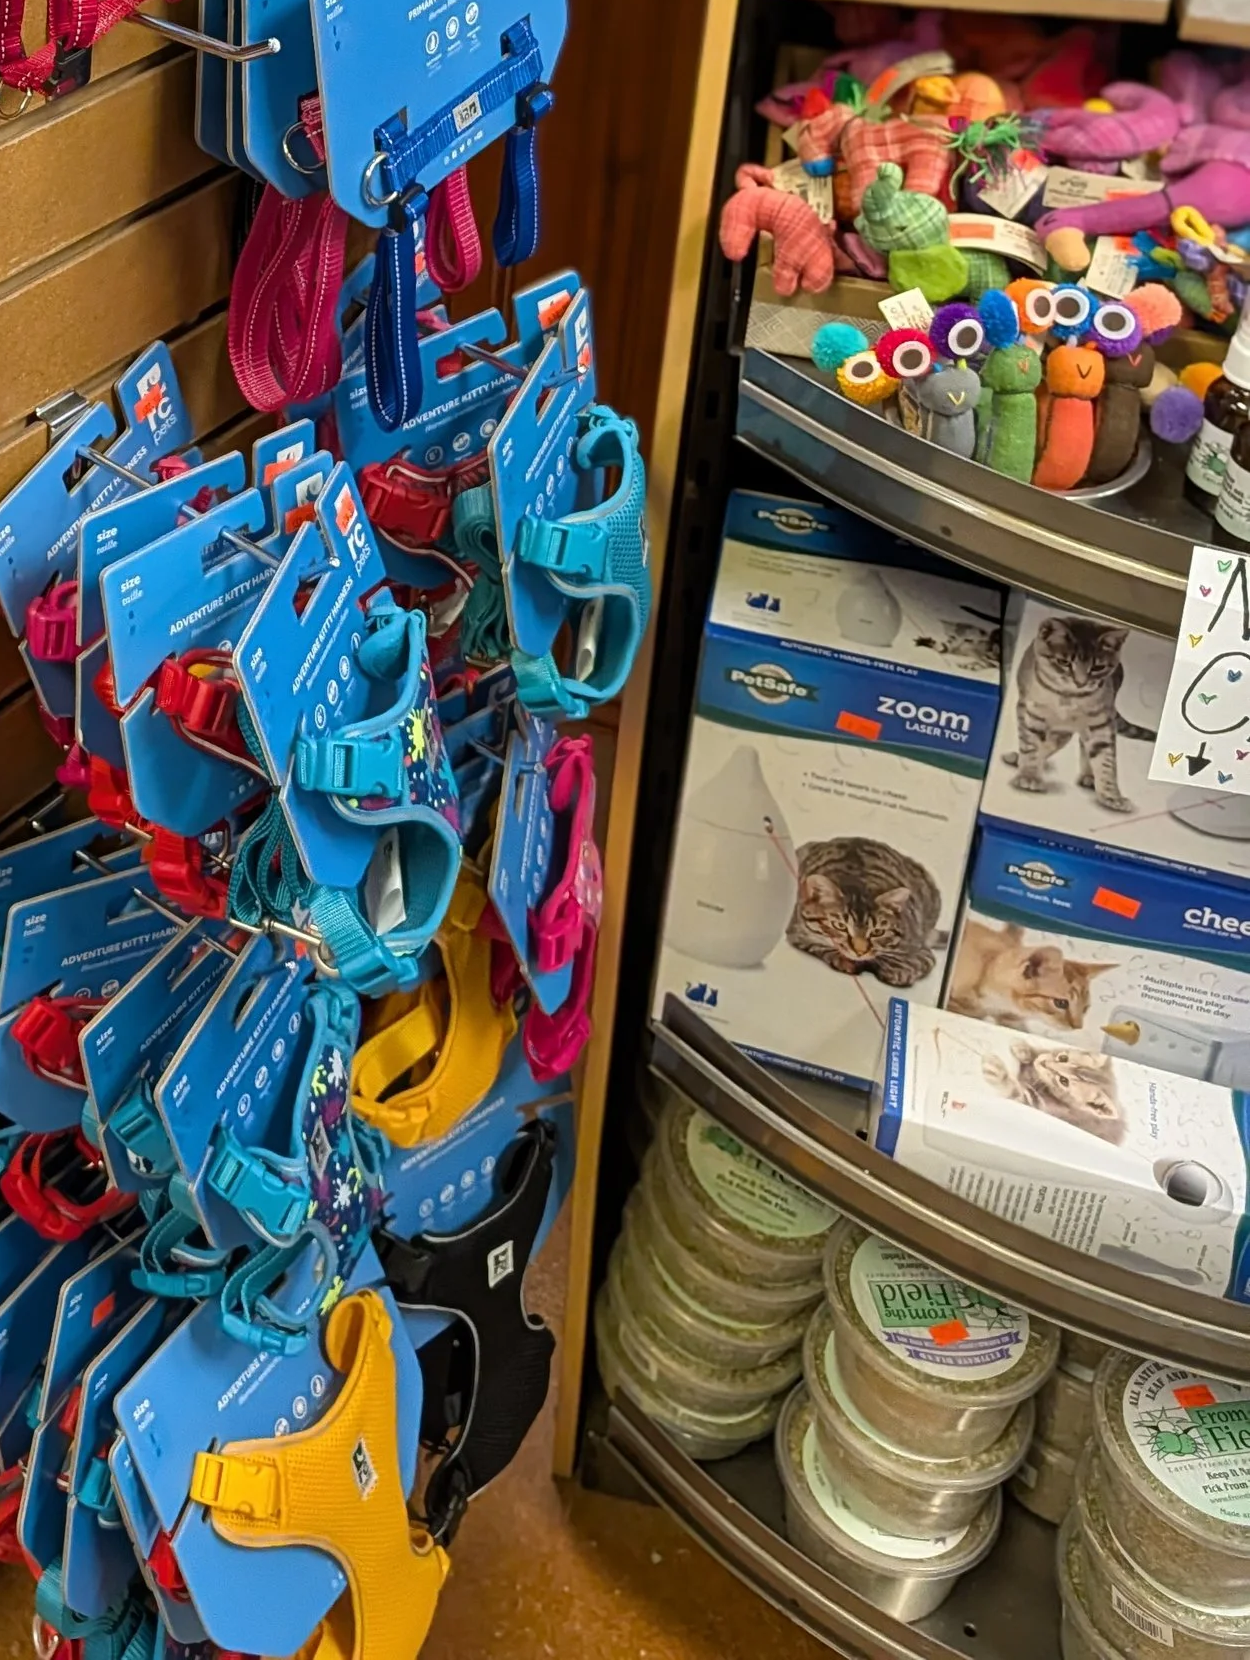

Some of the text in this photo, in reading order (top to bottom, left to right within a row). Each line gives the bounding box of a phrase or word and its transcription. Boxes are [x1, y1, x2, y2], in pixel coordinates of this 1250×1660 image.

[402, 384, 491, 432] ADVENTURE KITTY
[152, 412, 179, 445] pets
[757, 509, 830, 531] PetSafe
[96, 527, 118, 543] size
[346, 522, 366, 560] rc
[120, 574, 142, 593] size
[169, 594, 224, 636] ADVENTURE
[224, 579, 252, 603] KITTY
[292, 634, 323, 695] ADVENTURE
[321, 609, 337, 639] KITTY
[334, 577, 354, 613] HARNESS
[250, 647, 263, 671] size
[730, 669, 807, 698] PetSafe
[877, 695, 971, 734] zoom
[905, 720, 969, 744] LASER TOY
[1007, 864, 1066, 887] PetSafe
[24, 911, 47, 928] size
[60, 933, 150, 968] ADVENTURE KITTY
[1143, 984, 1227, 1011] Spontaneous play
[1145, 974, 1183, 991] Multiple
[1184, 984, 1208, 997] mice
[1210, 989, 1221, 999] to
[1141, 992, 1232, 1021] throughout the day
[95, 1026, 114, 1047] size
[216, 1007, 274, 1100] ADVENTURE KITTY
[890, 1050, 901, 1079] LASER
[172, 1074, 189, 1100] size
[888, 1079, 899, 1109] LIGHT
[876, 1282, 953, 1308] Field
[885, 1307, 907, 1320] the
[1134, 1362, 1169, 1391] NATUR
[1145, 1370, 1189, 1402] LEAF AND
[131, 1398, 151, 1422] size
[1196, 1409, 1248, 1425] From
[1206, 1468, 1230, 1481] Keep
[1231, 1467, 1240, 1477] It
[1202, 1481, 1249, 1495] Pick From
